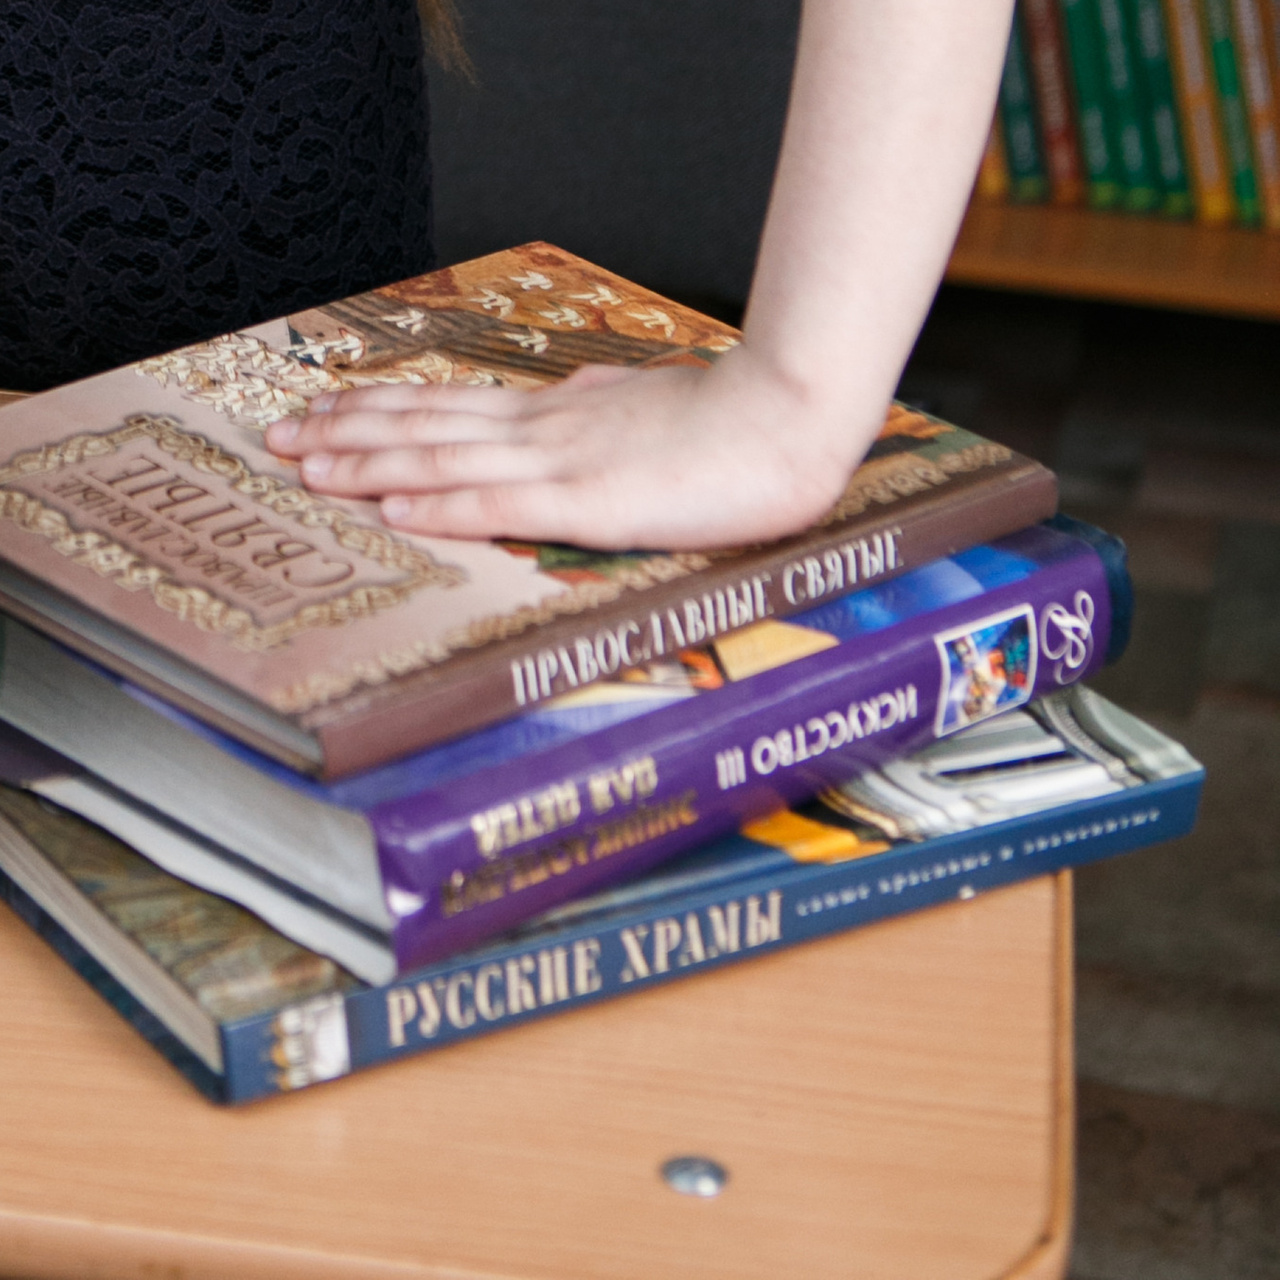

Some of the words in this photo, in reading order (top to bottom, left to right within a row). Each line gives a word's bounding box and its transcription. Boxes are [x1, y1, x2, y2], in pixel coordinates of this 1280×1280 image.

[42, 476, 295, 607] ПРАВОСЛАВНЫЕ
[87, 455, 354, 588] СВЯТЫЕ
[511, 572, 774, 706] ПРАВОСЛАВНЫЕ
[783, 526, 905, 606] СВЯТЫЕ
[715, 745, 747, 790] III
[750, 683, 918, 775] ИСКУССТВО
[385, 936, 603, 1048] РУССКИЕ
[619, 888, 783, 984] ХРАМЫ
